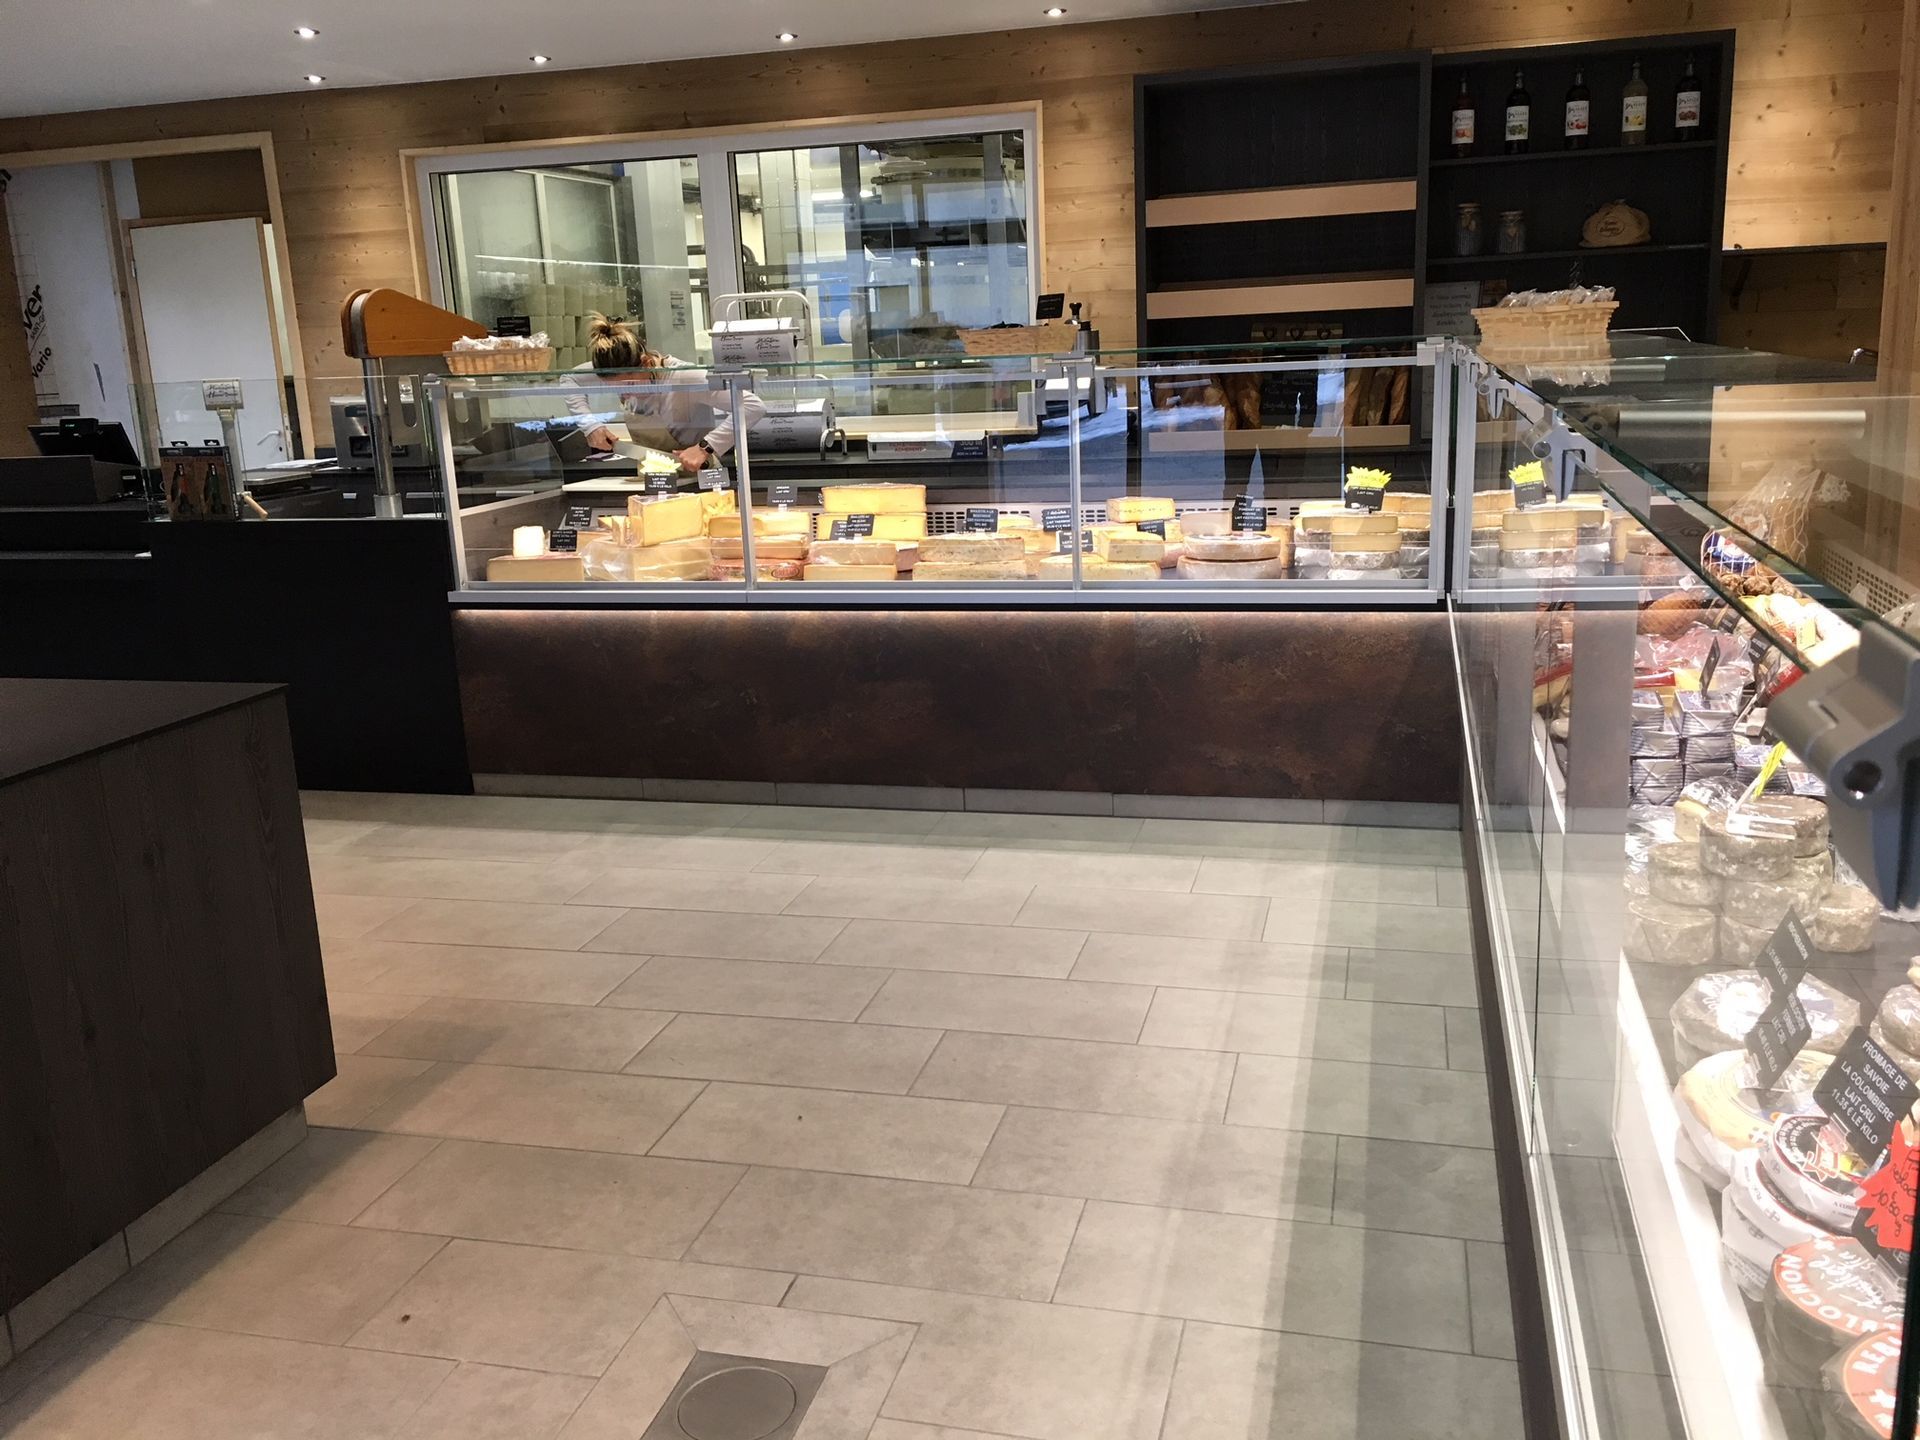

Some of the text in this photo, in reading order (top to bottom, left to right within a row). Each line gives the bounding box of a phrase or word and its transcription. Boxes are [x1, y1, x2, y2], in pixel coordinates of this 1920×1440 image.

[24, 284, 43, 338] ver
[1862, 1040, 1908, 1091] FROMAGE DE
[1863, 1064, 1890, 1094] SAVOIE
[1840, 1061, 1895, 1122] LA COLOMBIERE
[1844, 1087, 1876, 1122] LAIT CRU
[1846, 1108, 1853, 1116] €
[1850, 1113, 1861, 1126] LE
[1860, 1124, 1878, 1145] KILO
